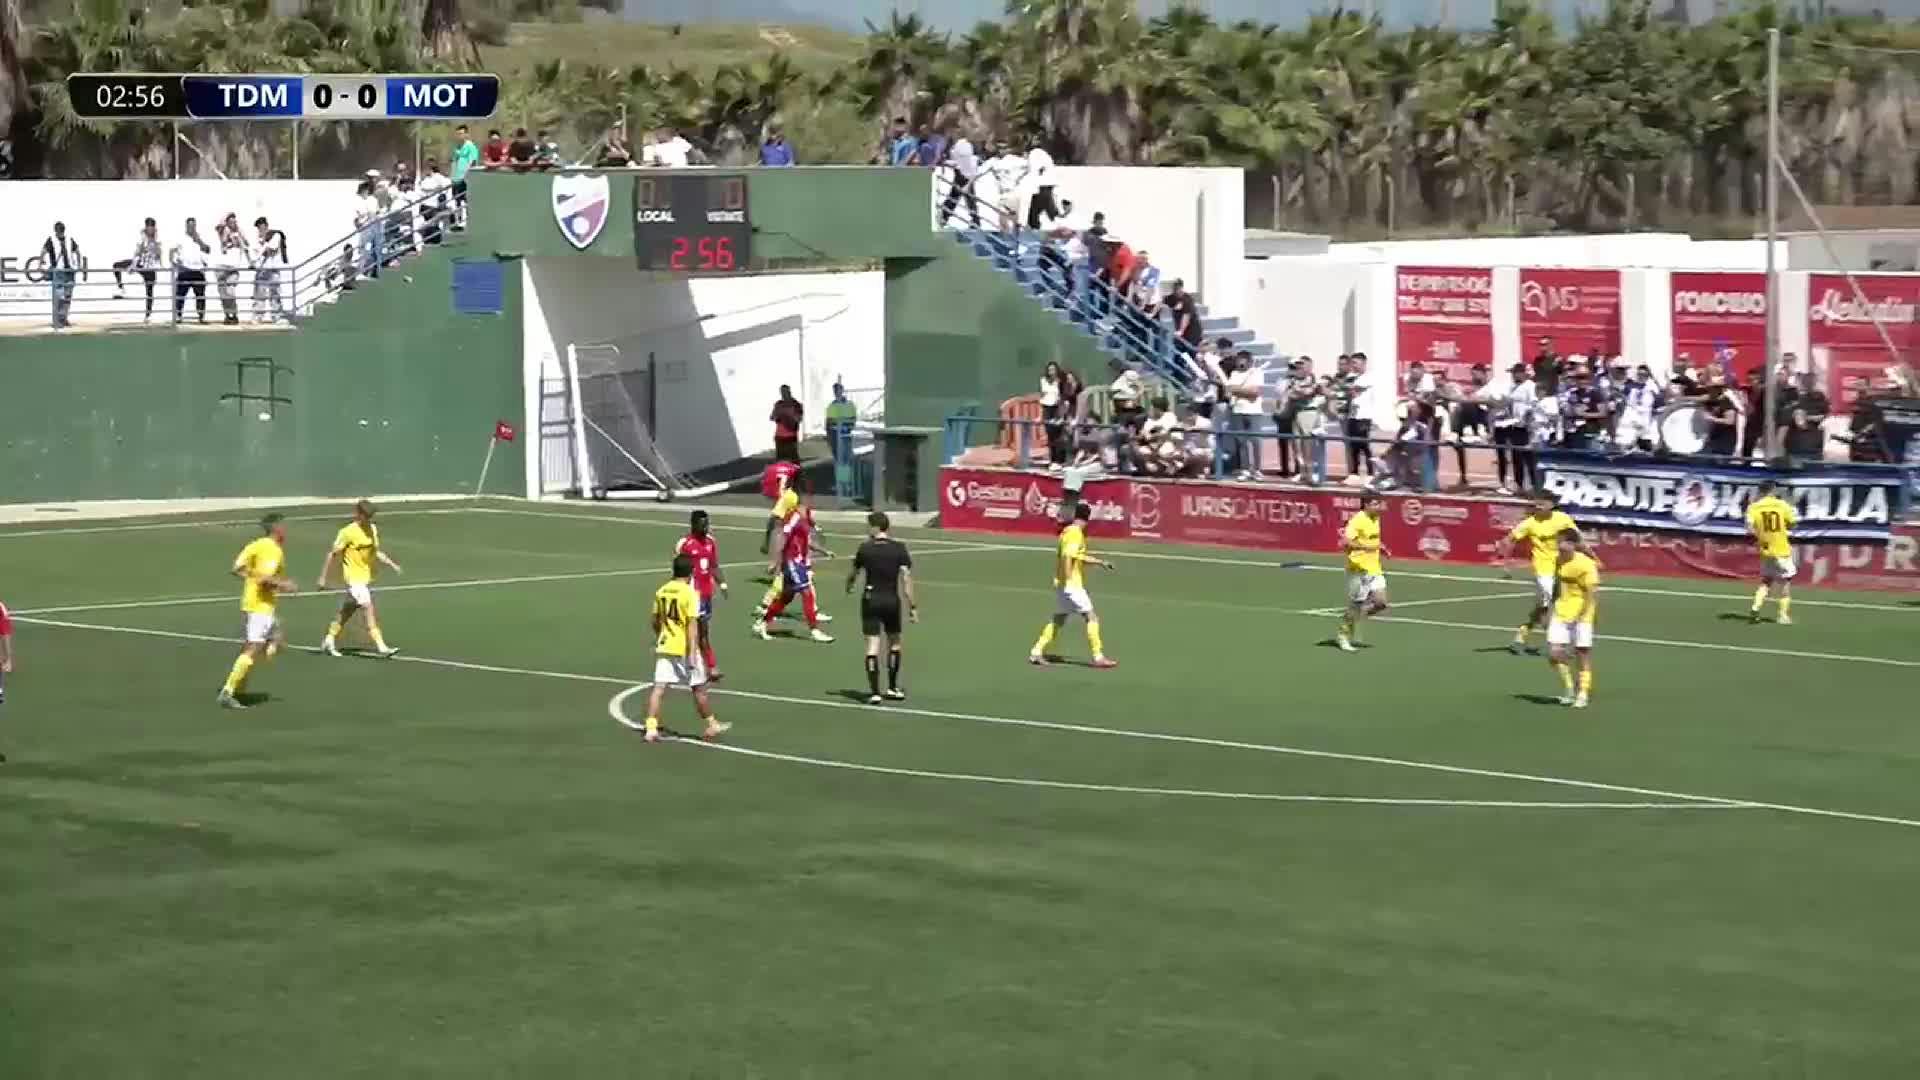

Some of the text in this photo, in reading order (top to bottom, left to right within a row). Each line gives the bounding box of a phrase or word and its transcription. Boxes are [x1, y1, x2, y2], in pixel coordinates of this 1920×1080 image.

[637, 210, 676, 223] LOCAL
[1543, 470, 1679, 513] FRENTE
[1760, 510, 1781, 533] 10
[658, 597, 681, 624] 14
